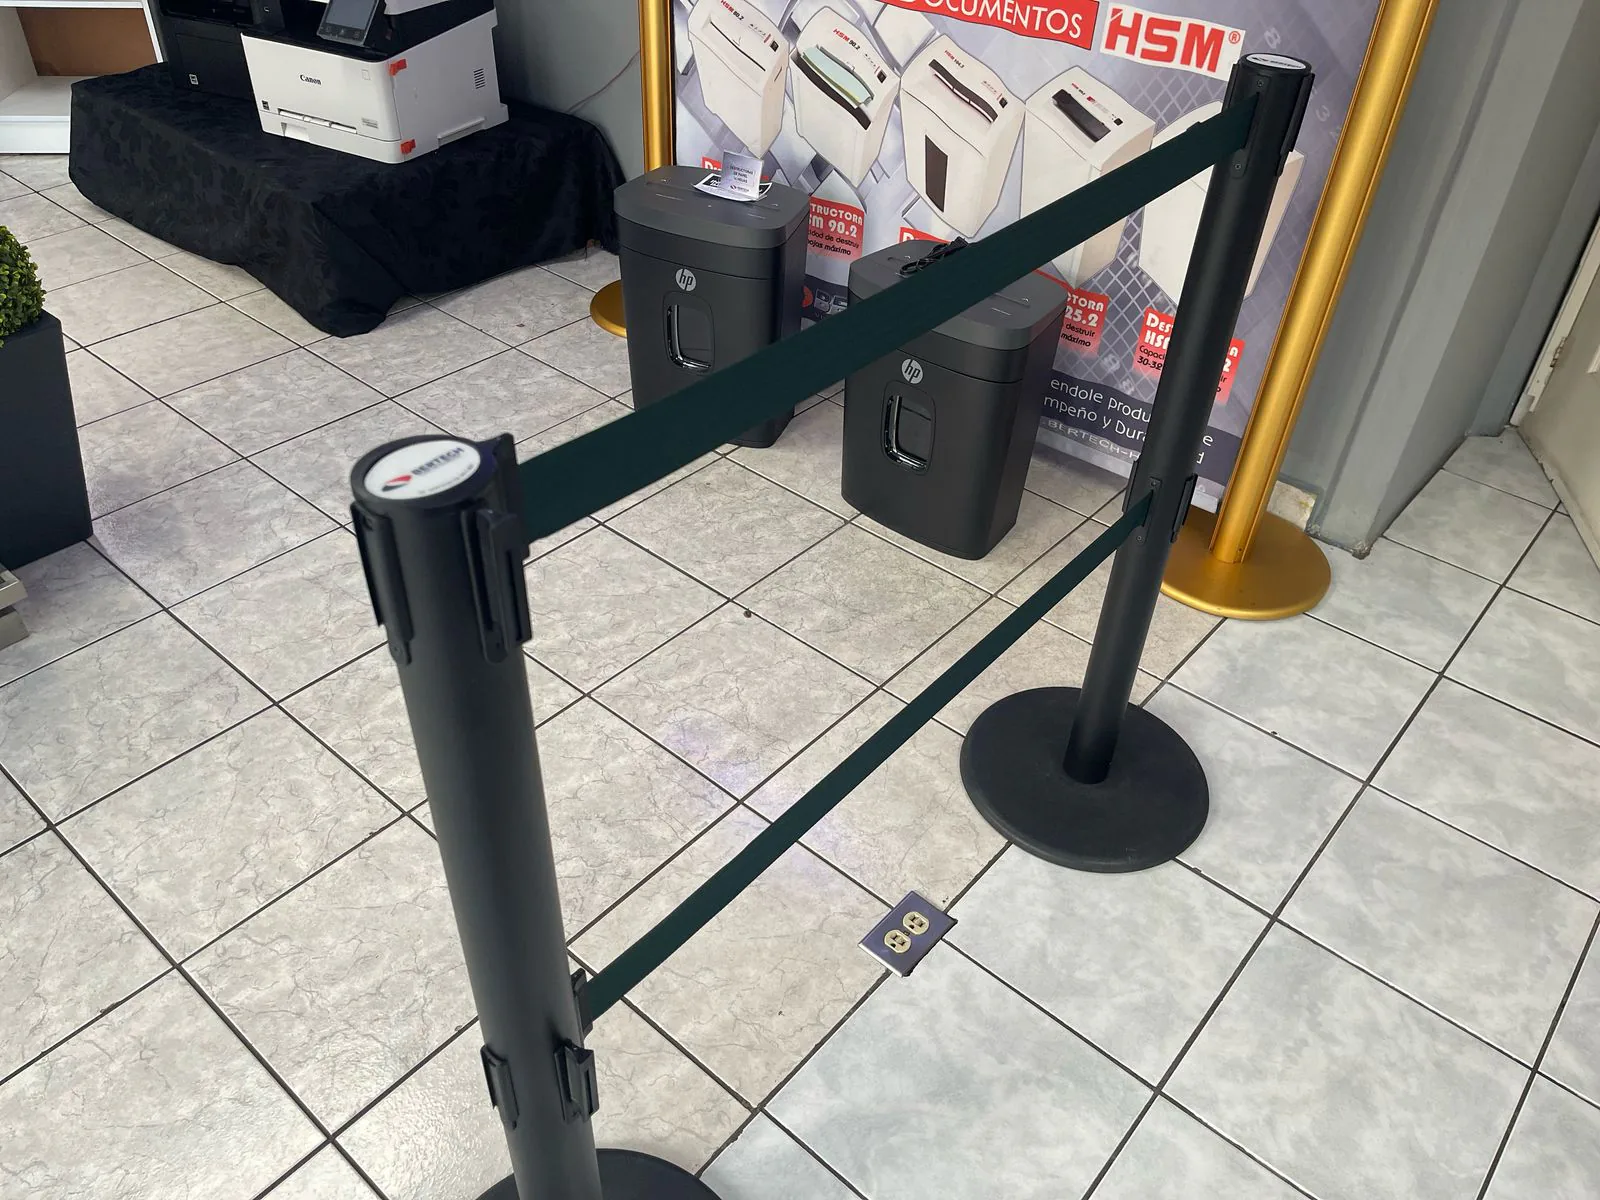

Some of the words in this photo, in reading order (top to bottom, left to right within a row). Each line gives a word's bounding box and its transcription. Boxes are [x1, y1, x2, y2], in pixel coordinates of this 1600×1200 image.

[900, 0, 1082, 38] CUMENTOS
[833, 28, 850, 42] HSM
[300, 74, 322, 86] Canon
[828, 219, 858, 238] 90.2
[824, 233, 834, 242] de
[825, 243, 852, 256] máximo
[676, 268, 696, 292] hp
[1065, 323, 1096, 338] destruir
[1060, 332, 1092, 347] máximo
[902, 358, 922, 384] hp
[1050, 378, 1104, 403] endole
[1043, 395, 1098, 422] mpeño
[1102, 415, 1112, 429] y
